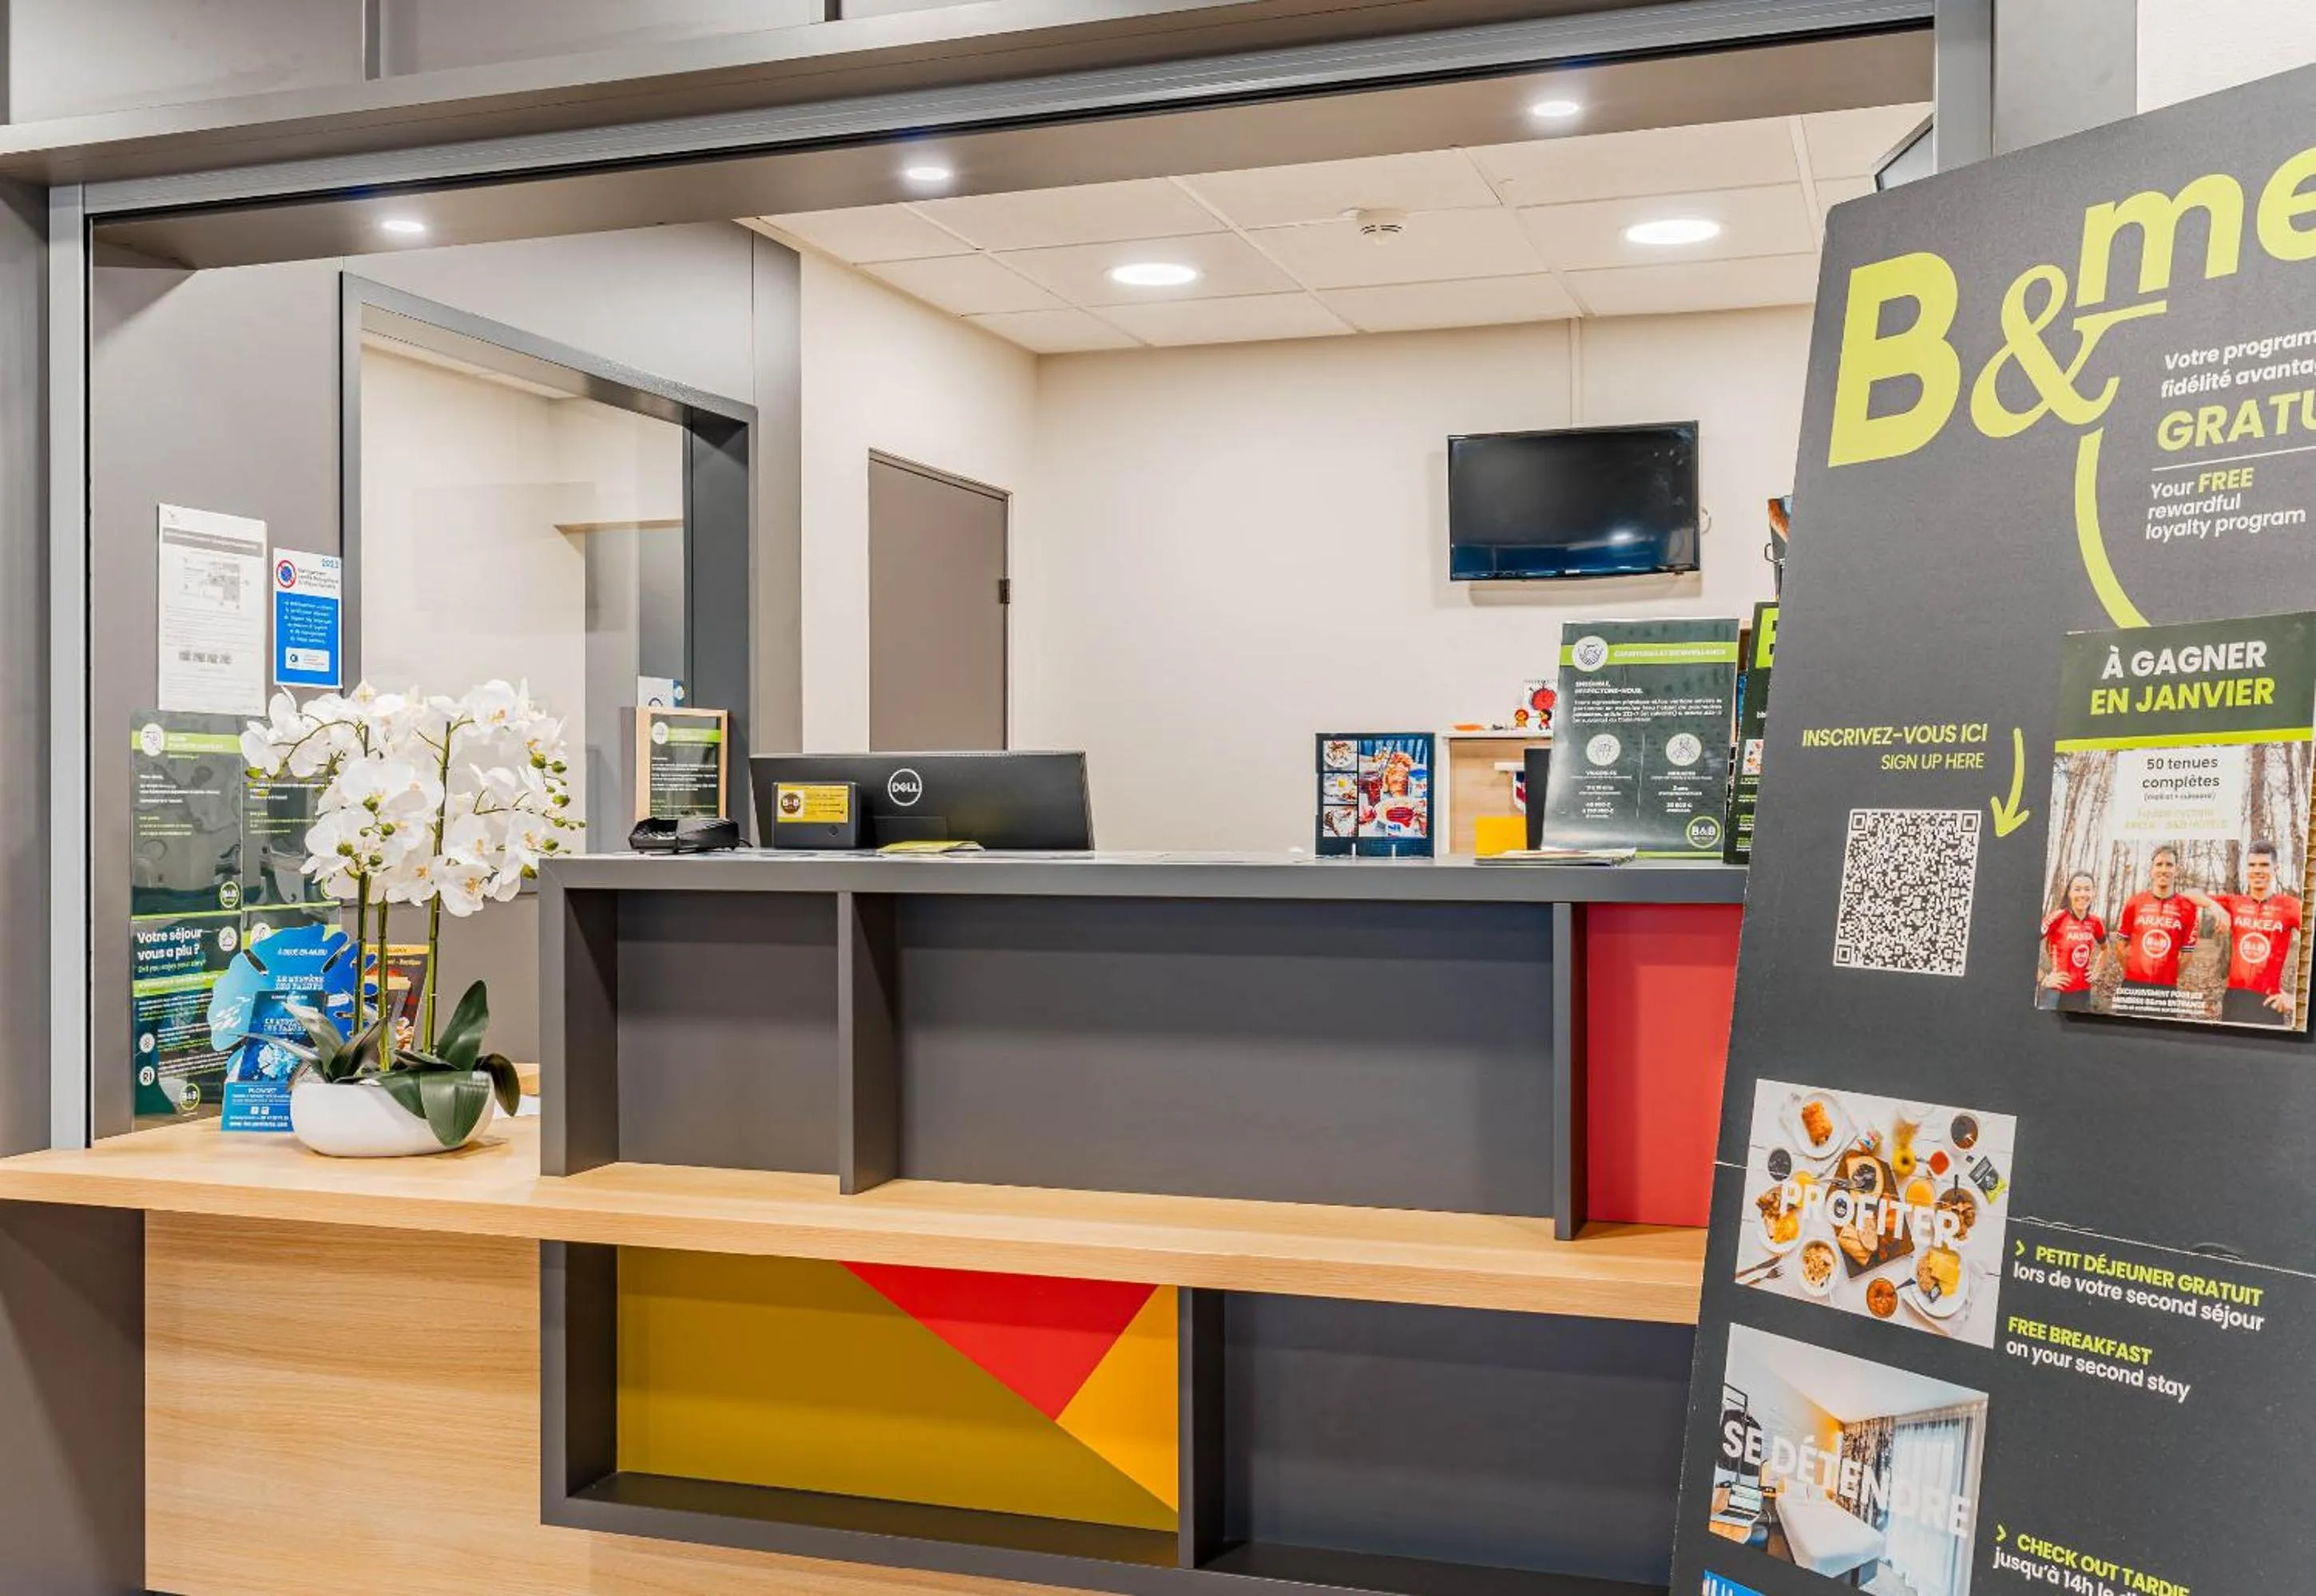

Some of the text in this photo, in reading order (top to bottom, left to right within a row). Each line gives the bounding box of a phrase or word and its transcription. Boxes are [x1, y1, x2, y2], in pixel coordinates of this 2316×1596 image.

[2164, 329, 2316, 370] Votre program
[2161, 358, 2316, 398] fidélité avanta
[2151, 467, 2255, 500] Your FREE
[2145, 508, 2306, 543] loyalty program
[2147, 493, 2241, 520] rewardful
[2101, 640, 2267, 679] À GAGNER
[2090, 677, 2275, 715] EN JANVIER
[1802, 723, 1989, 747] INSCRIVEZ-VOUS ICI
[1881, 752, 1985, 770] SIGN UP HERE
[2147, 757, 2218, 770] 50 tenues
[891, 782, 919, 792] DELL
[2142, 774, 2220, 790] complètes
[1691, 826, 1716, 835] B&B
[137, 928, 203, 944] Votre séjour
[137, 949, 165, 960] vous
[165, 949, 174, 958] a
[176, 945, 192, 960] plu
[1779, 1178, 1965, 1250] PROFITER
[2036, 1245, 2264, 1307] PETIT DÉJEUNER GRATUIT
[2013, 1261, 2265, 1331] lors de votre second séjour
[2008, 1316, 2152, 1365] FREE BREAKFAST
[2006, 1340, 2191, 1403] on your second stay
[1722, 1420, 1971, 1539] SE DÉTENDRE
[1993, 1546, 2060, 1585] jusqu'à
[2064, 1570, 2094, 1596] 14h
[2017, 1534, 2079, 1569] CHECK
[2080, 1555, 2120, 1581] OUT
